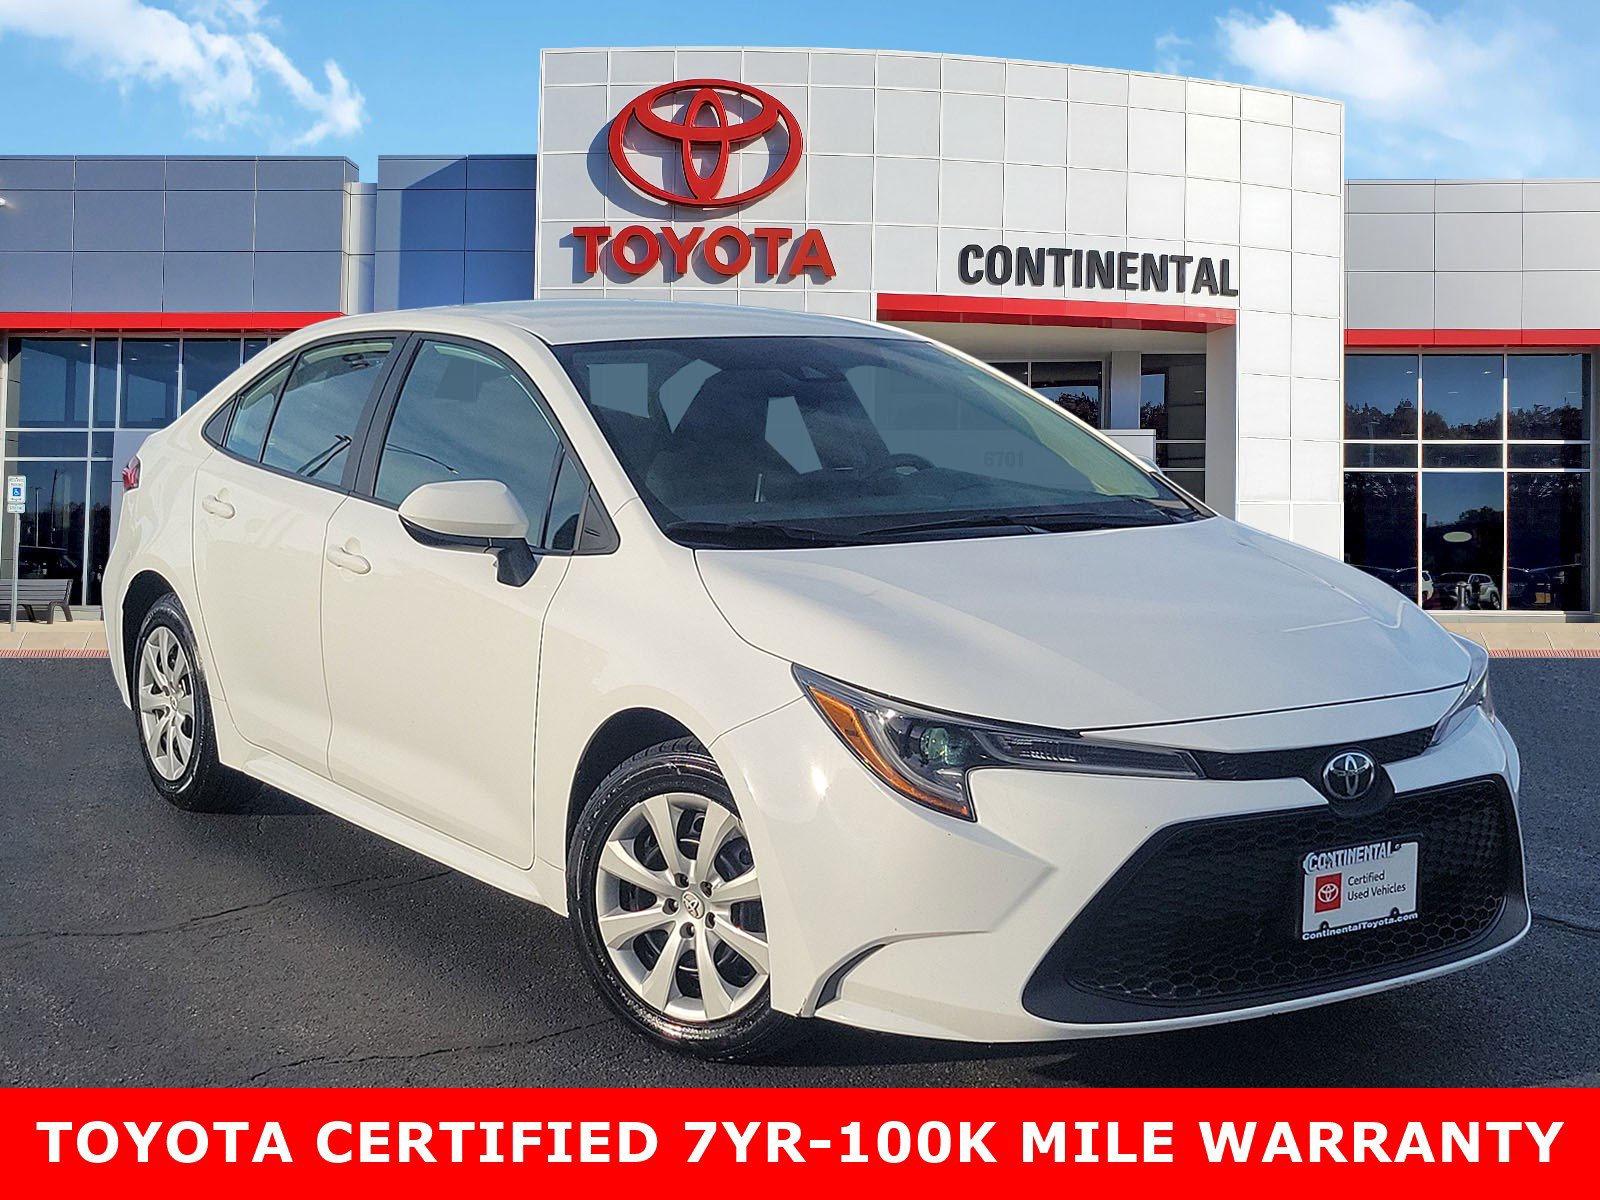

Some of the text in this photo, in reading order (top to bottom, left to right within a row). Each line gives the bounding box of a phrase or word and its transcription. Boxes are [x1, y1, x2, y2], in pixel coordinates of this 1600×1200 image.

[572, 225, 837, 277] TOYOTA
[958, 244, 1239, 297] CONTINENTAL
[984, 451, 1024, 468] 6701
[1303, 841, 1394, 874] CONTINENTAL
[1347, 870, 1385, 886] Certified
[1347, 882, 1406, 901] Used Vehicles
[1302, 912, 1418, 941] ContinentalToyota.com
